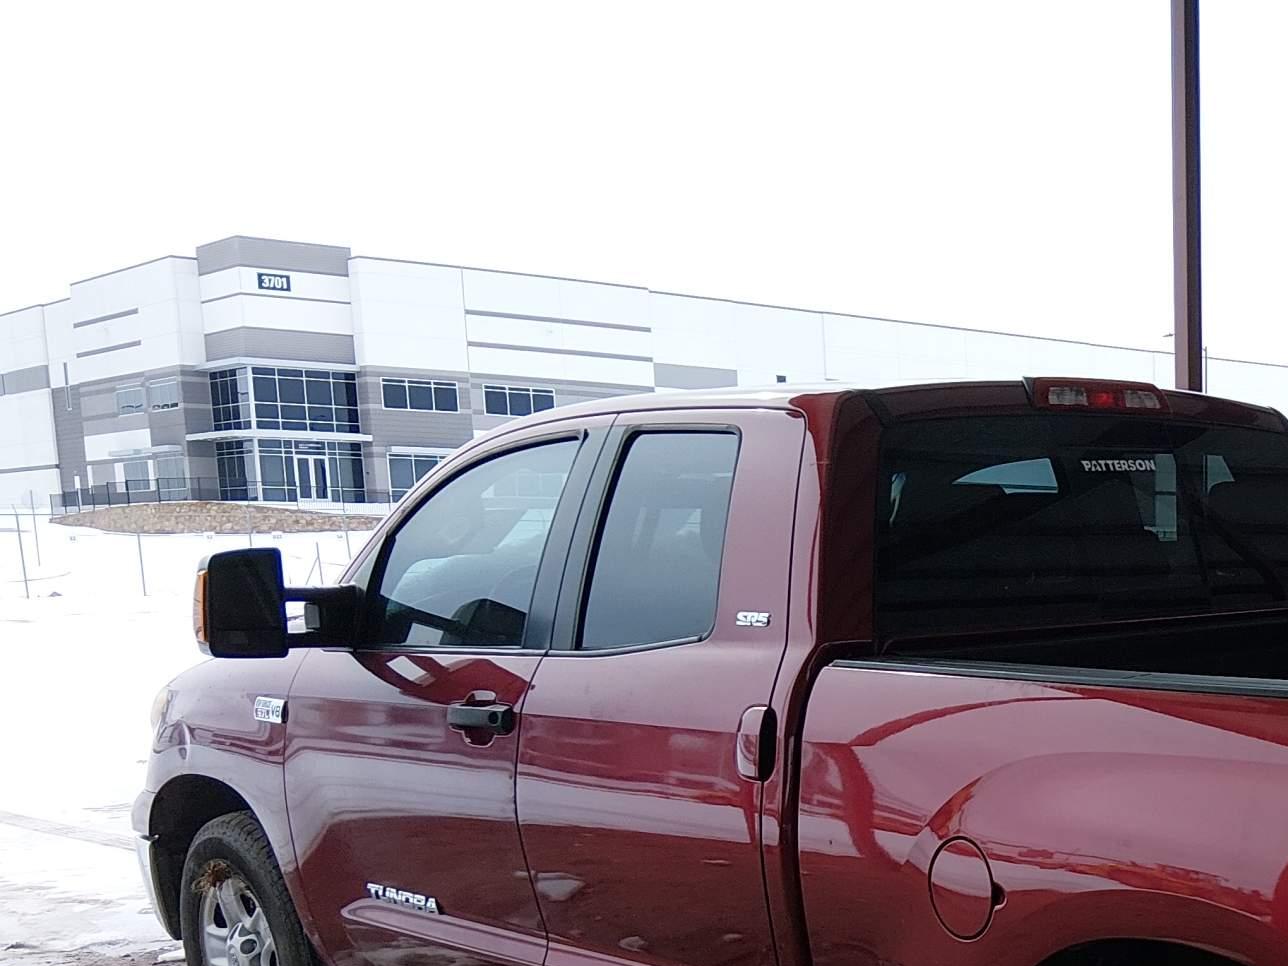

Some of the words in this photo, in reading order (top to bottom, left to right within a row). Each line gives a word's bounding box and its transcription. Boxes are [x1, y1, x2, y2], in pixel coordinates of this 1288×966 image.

[261, 275, 288, 290] 3701
[1081, 459, 1157, 472] PATTERSON
[736, 611, 771, 627] SR5
[366, 882, 440, 915] TUNDRA
